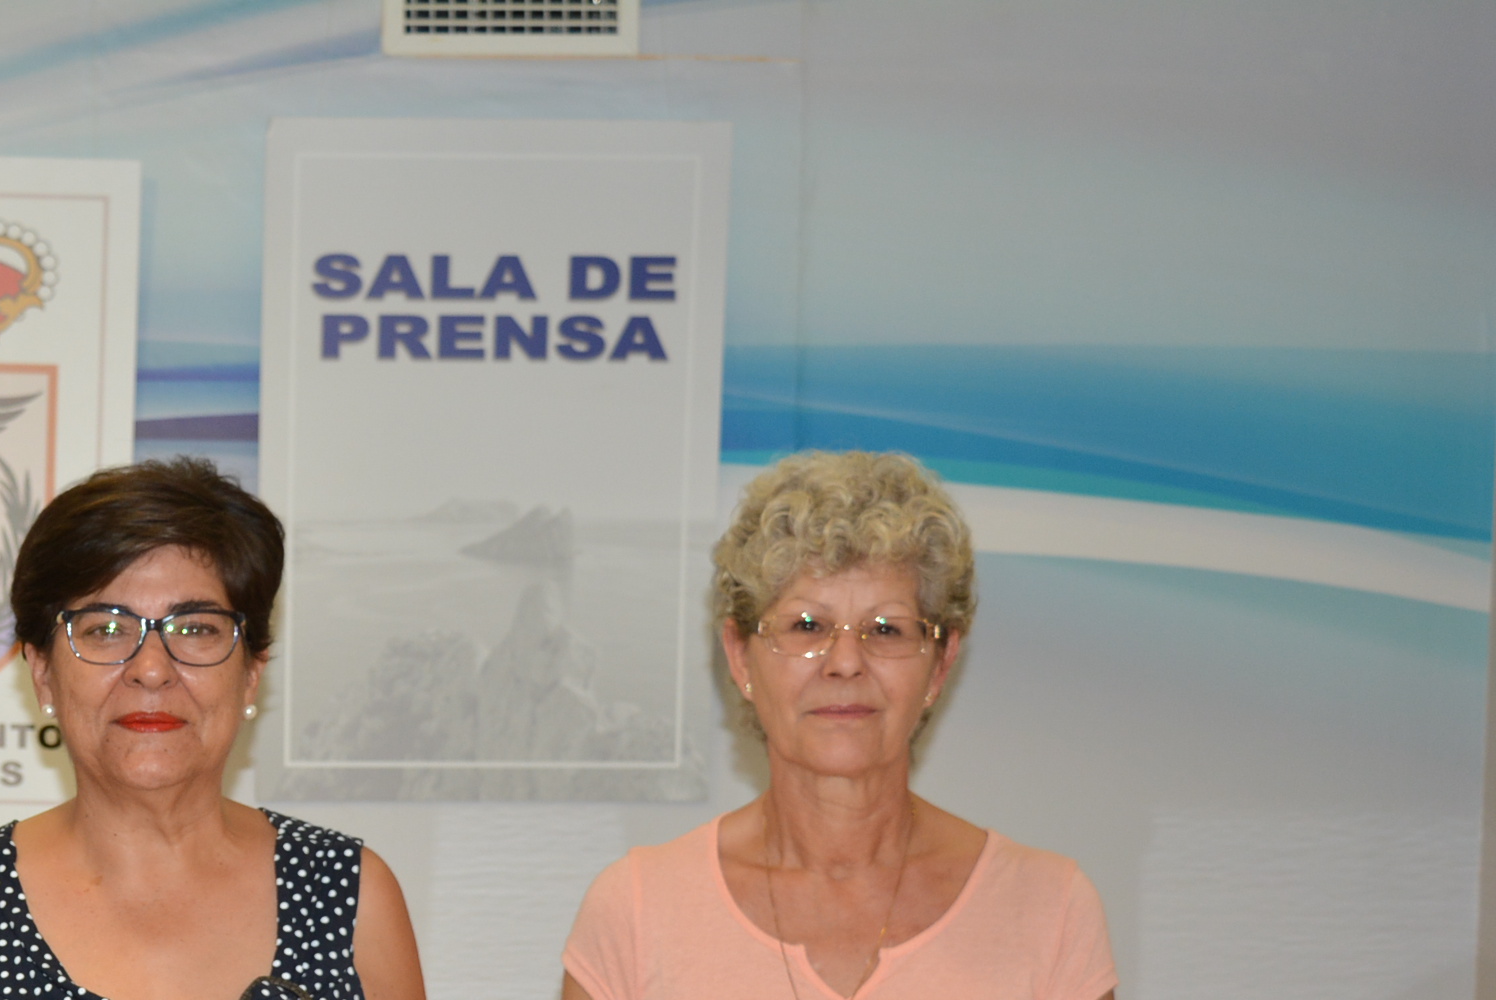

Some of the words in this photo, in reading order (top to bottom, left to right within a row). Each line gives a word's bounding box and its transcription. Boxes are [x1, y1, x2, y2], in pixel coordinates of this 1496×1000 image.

[312, 253, 537, 300] SALA
[569, 256, 677, 300] DE
[320, 313, 669, 362] PRENSA
